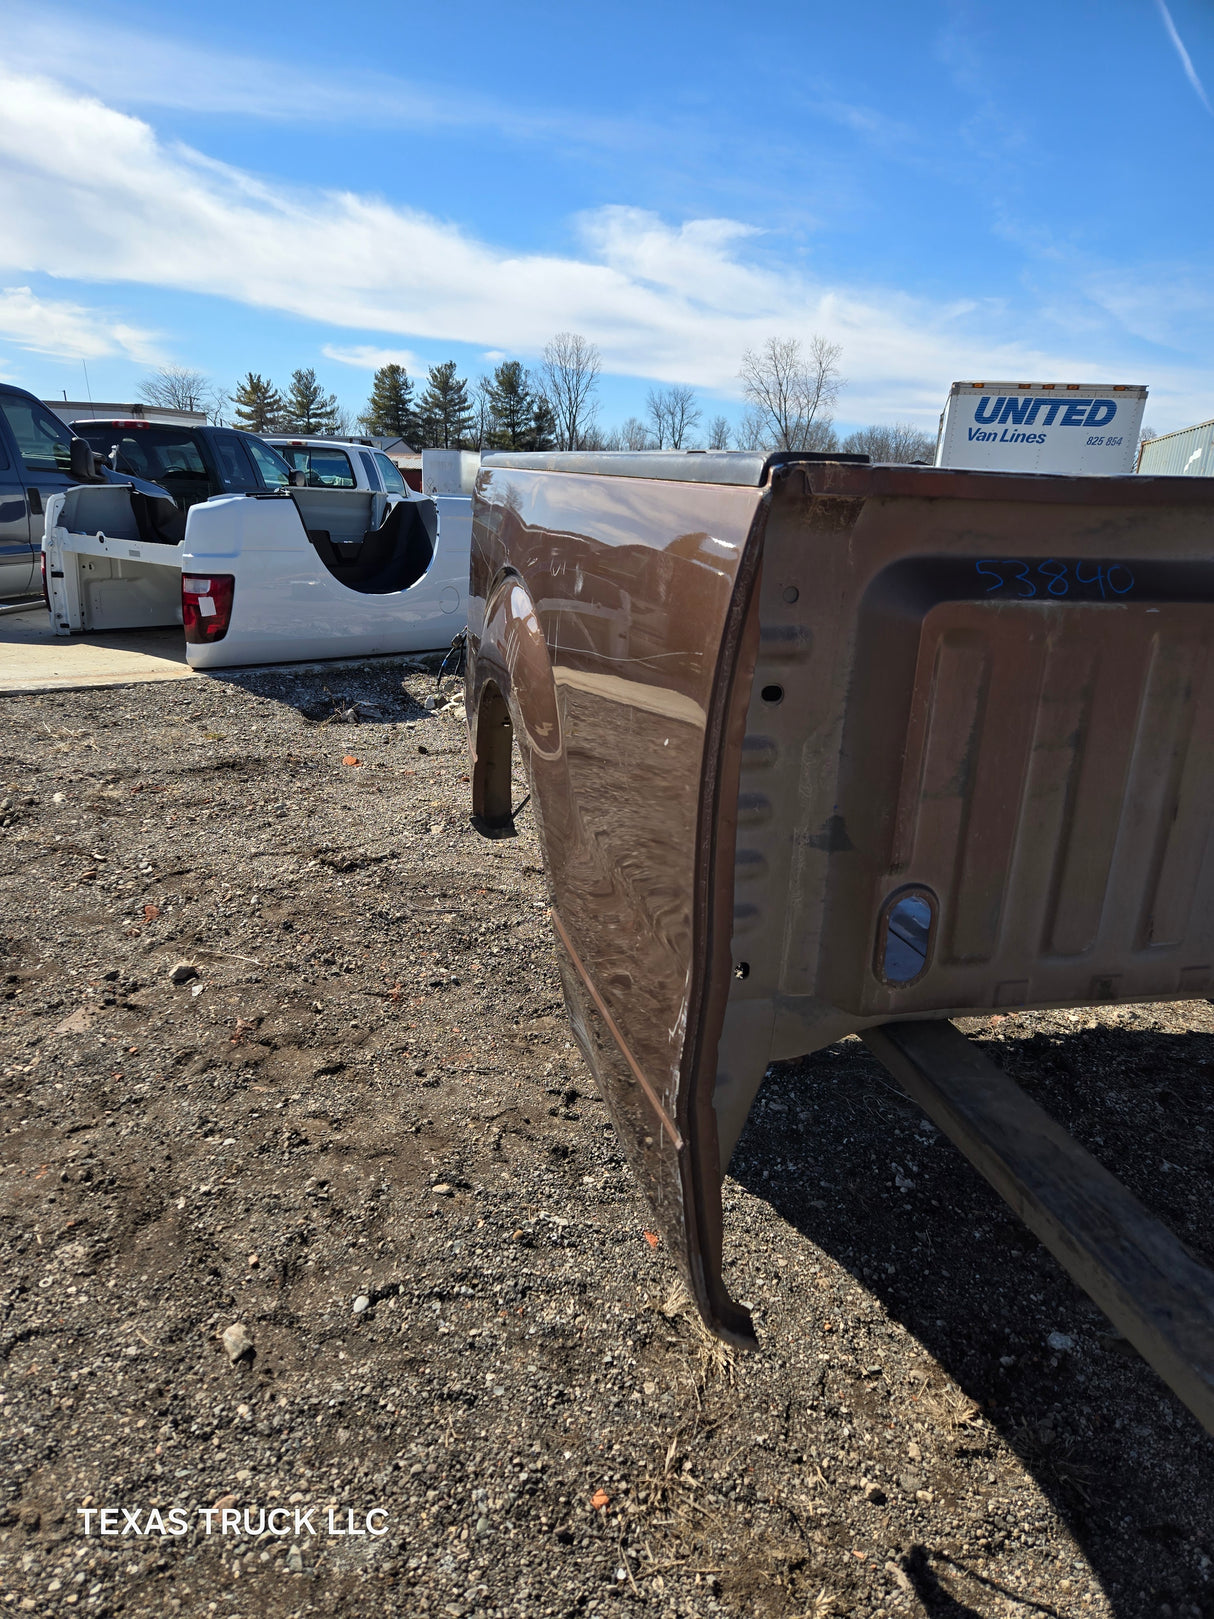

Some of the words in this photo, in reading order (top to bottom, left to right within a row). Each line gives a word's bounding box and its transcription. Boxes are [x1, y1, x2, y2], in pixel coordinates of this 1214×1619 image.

[974, 396, 1118, 428] UNITED
[967, 426, 998, 443] Van
[1000, 428, 1047, 444] Lines
[1086, 436, 1104, 446] 825
[1105, 437, 1122, 447] 854
[975, 559, 1135, 600] 53840
